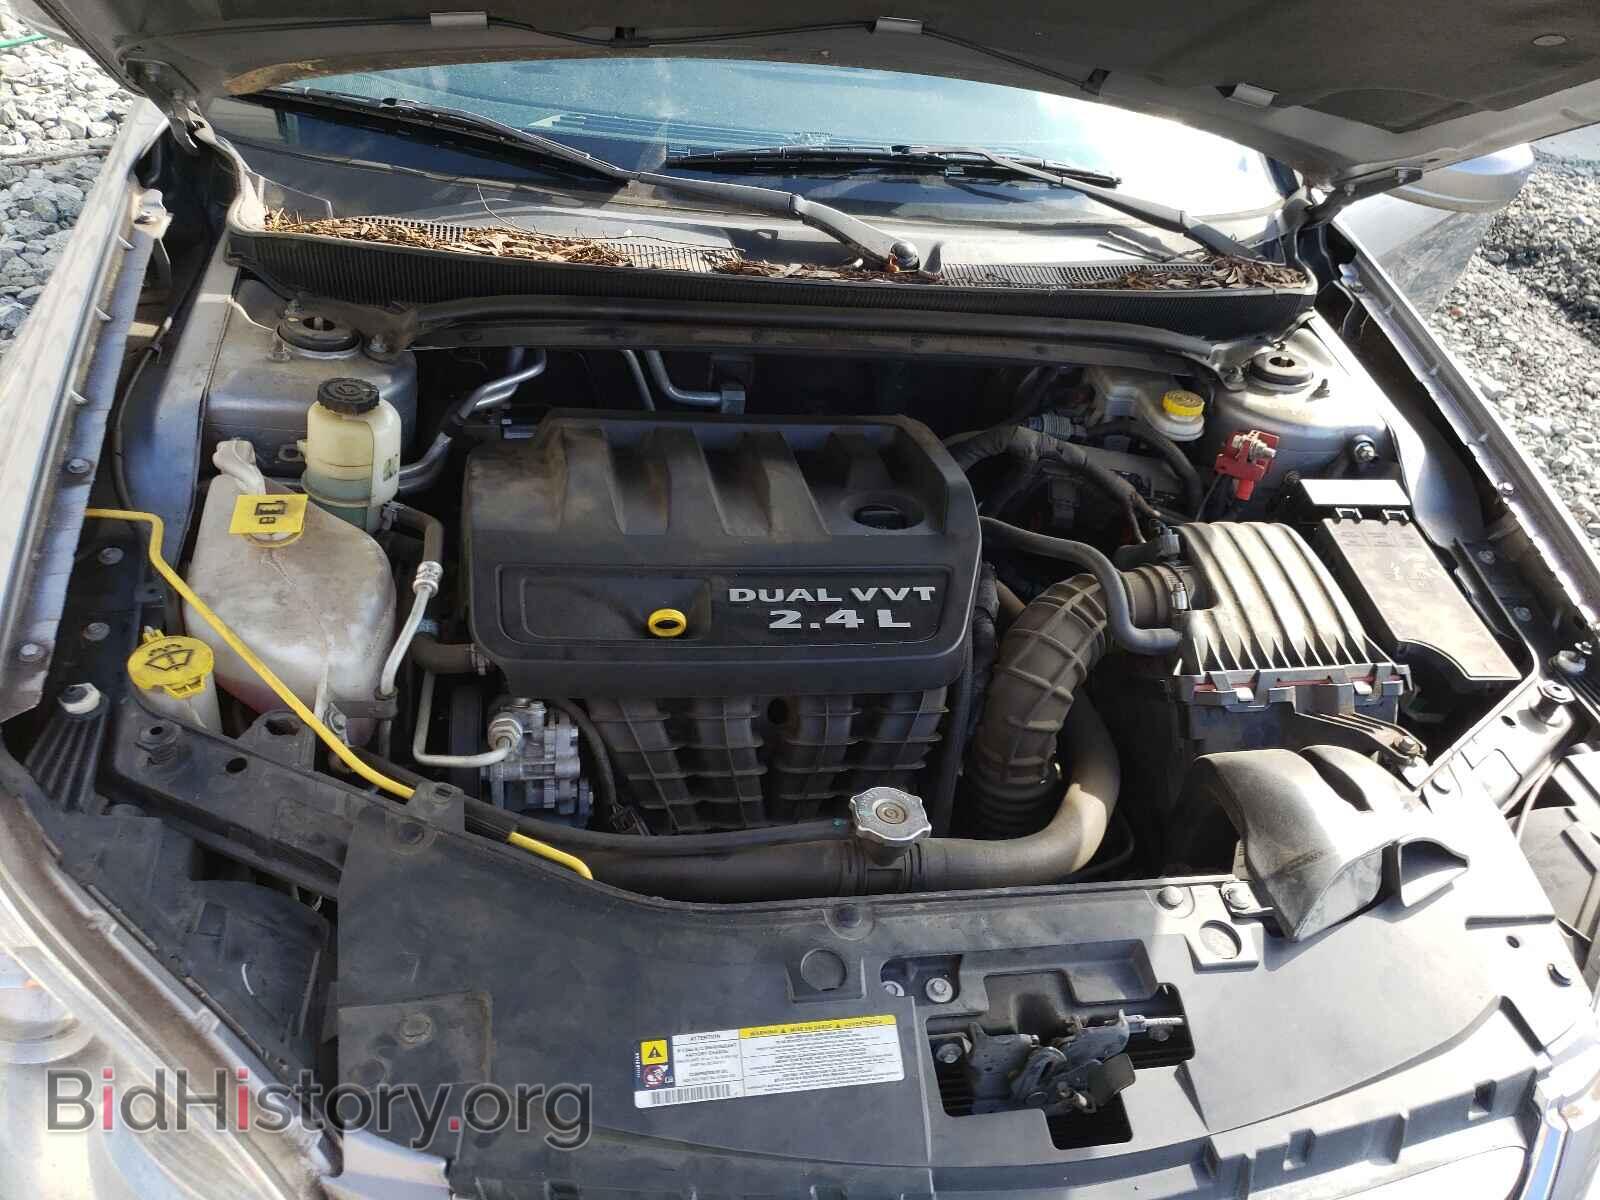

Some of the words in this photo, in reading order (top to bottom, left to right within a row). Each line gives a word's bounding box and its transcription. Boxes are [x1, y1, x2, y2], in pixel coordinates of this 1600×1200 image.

[728, 588, 842, 602] DUAL
[850, 586, 936, 601] VVT
[769, 609, 864, 629] 2.4
[877, 609, 911, 628] L
